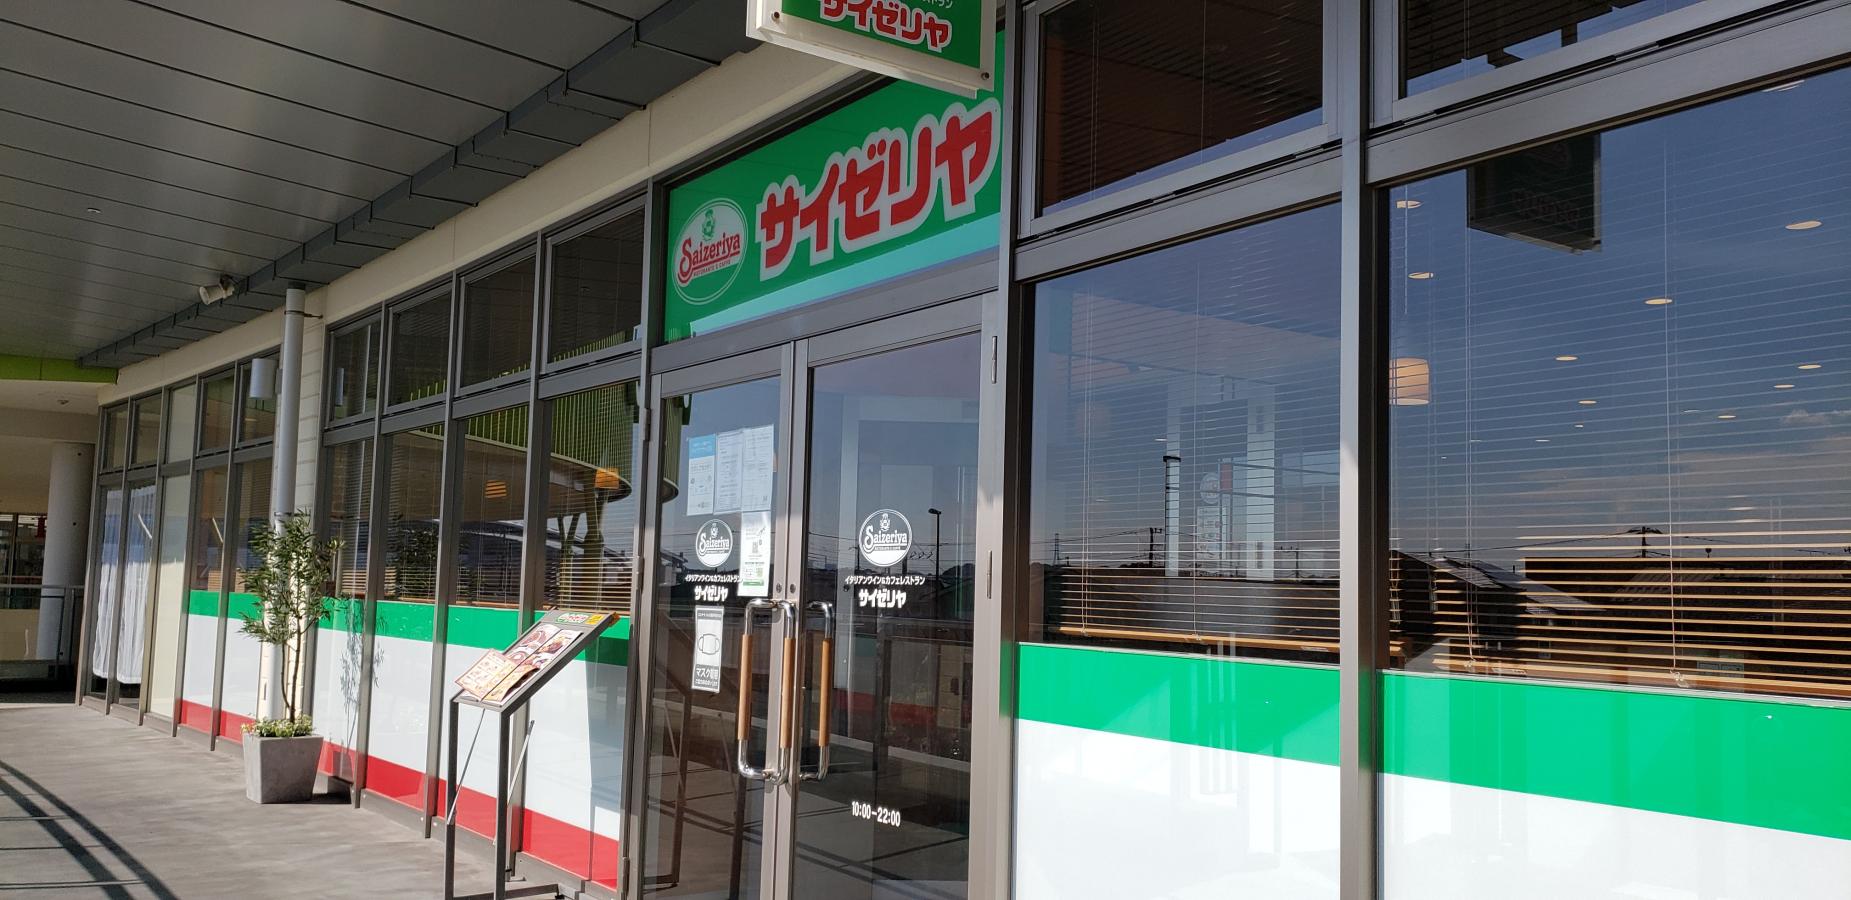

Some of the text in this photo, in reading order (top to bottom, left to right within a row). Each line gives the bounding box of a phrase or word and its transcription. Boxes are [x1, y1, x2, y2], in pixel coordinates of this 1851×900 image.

[758, 104, 997, 275] サイゼリヤ
[677, 232, 741, 284] Saizeriya
[699, 532, 730, 556] Saizeriya
[862, 525, 907, 552] Saizeriya
[694, 585, 728, 602] サイゼリヤ
[859, 588, 907, 608] サイゼリヤ
[852, 801, 900, 827] 10:00-22:00
